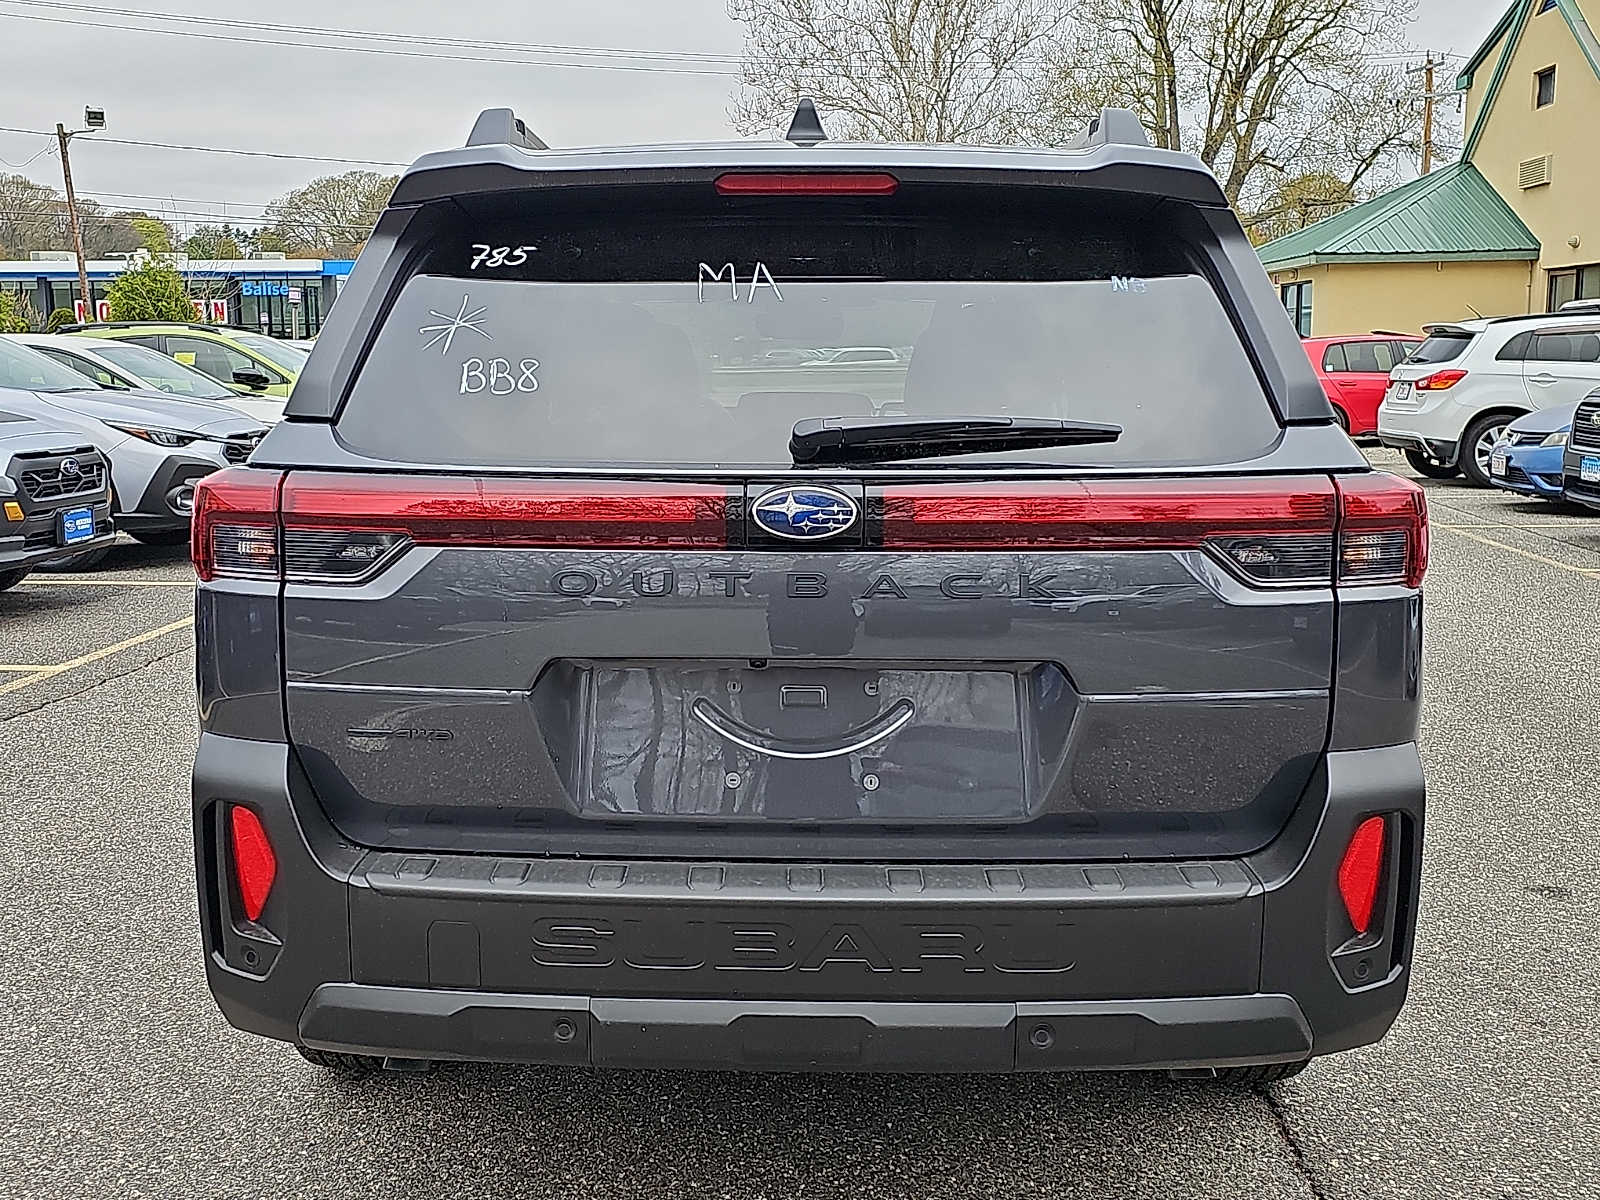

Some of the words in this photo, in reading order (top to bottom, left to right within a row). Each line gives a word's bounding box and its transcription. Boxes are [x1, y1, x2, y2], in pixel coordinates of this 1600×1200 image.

[470, 244, 537, 269] 785
[242, 281, 289, 296] Balise
[698, 262, 783, 303] MA
[460, 358, 540, 395] BB8
[551, 570, 1061, 599] OUTBACK
[531, 917, 1076, 974] SUBARU
